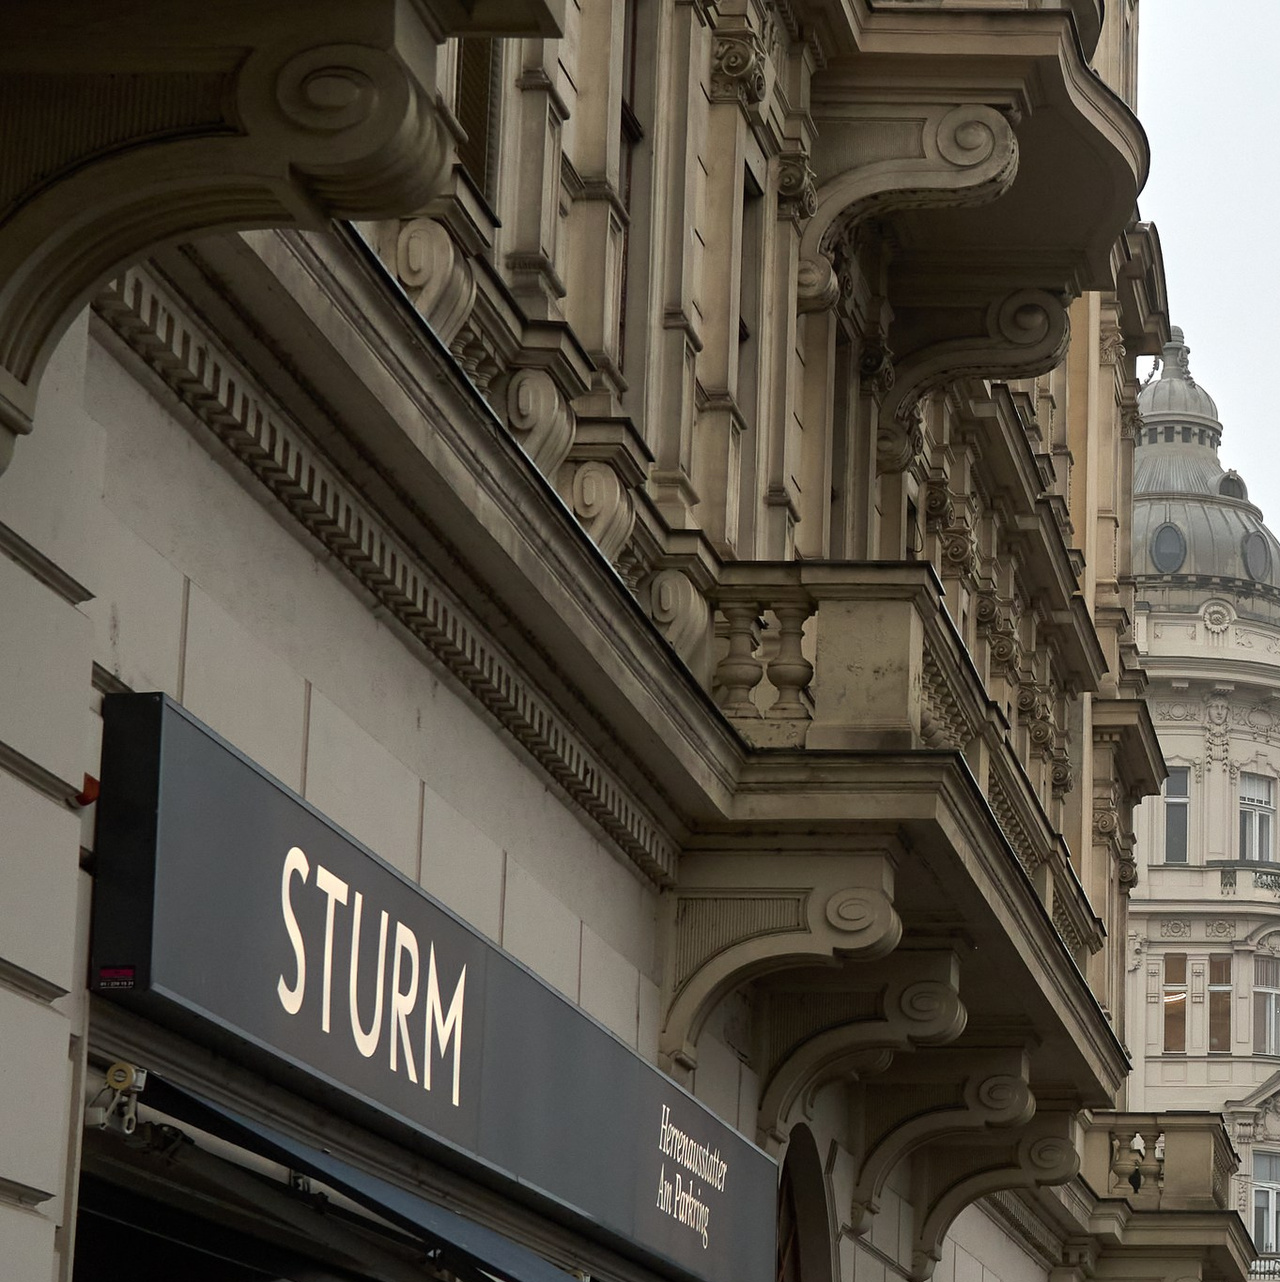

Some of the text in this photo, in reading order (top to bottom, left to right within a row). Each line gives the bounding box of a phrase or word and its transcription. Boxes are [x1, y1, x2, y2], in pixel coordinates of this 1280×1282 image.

[277, 846, 467, 1107] STURM
[659, 1104, 728, 1193] Herrenausstatter
[656, 1163, 710, 1249] Am Parkring
